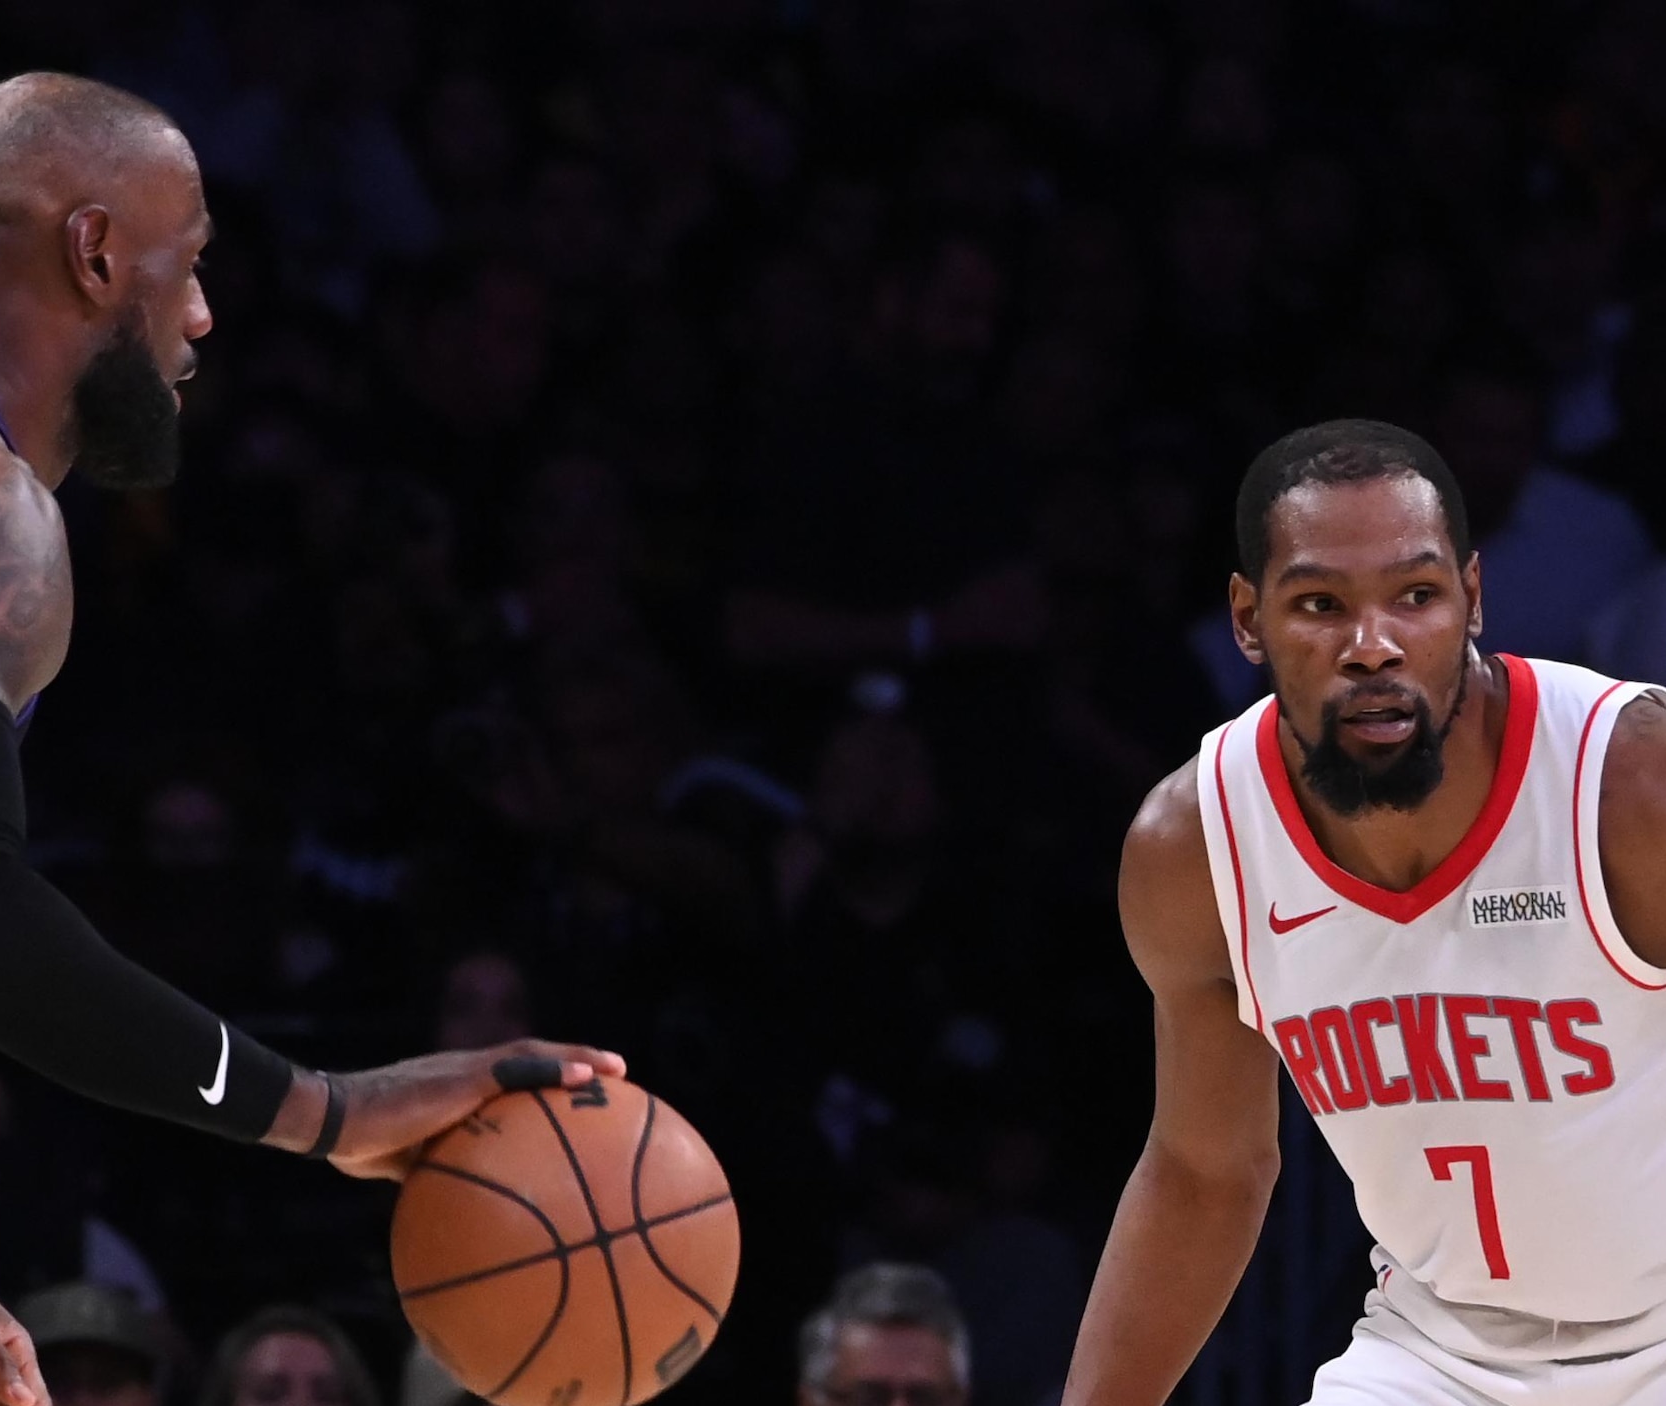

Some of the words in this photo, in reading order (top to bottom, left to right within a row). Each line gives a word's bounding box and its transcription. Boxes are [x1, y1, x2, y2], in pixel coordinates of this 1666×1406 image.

[1472, 891, 1566, 911] MEMORIAL
[1474, 903, 1566, 924] HERMANN
[1271, 993, 1615, 1116] ROCKETS
[1423, 1145, 1511, 1280] 7
